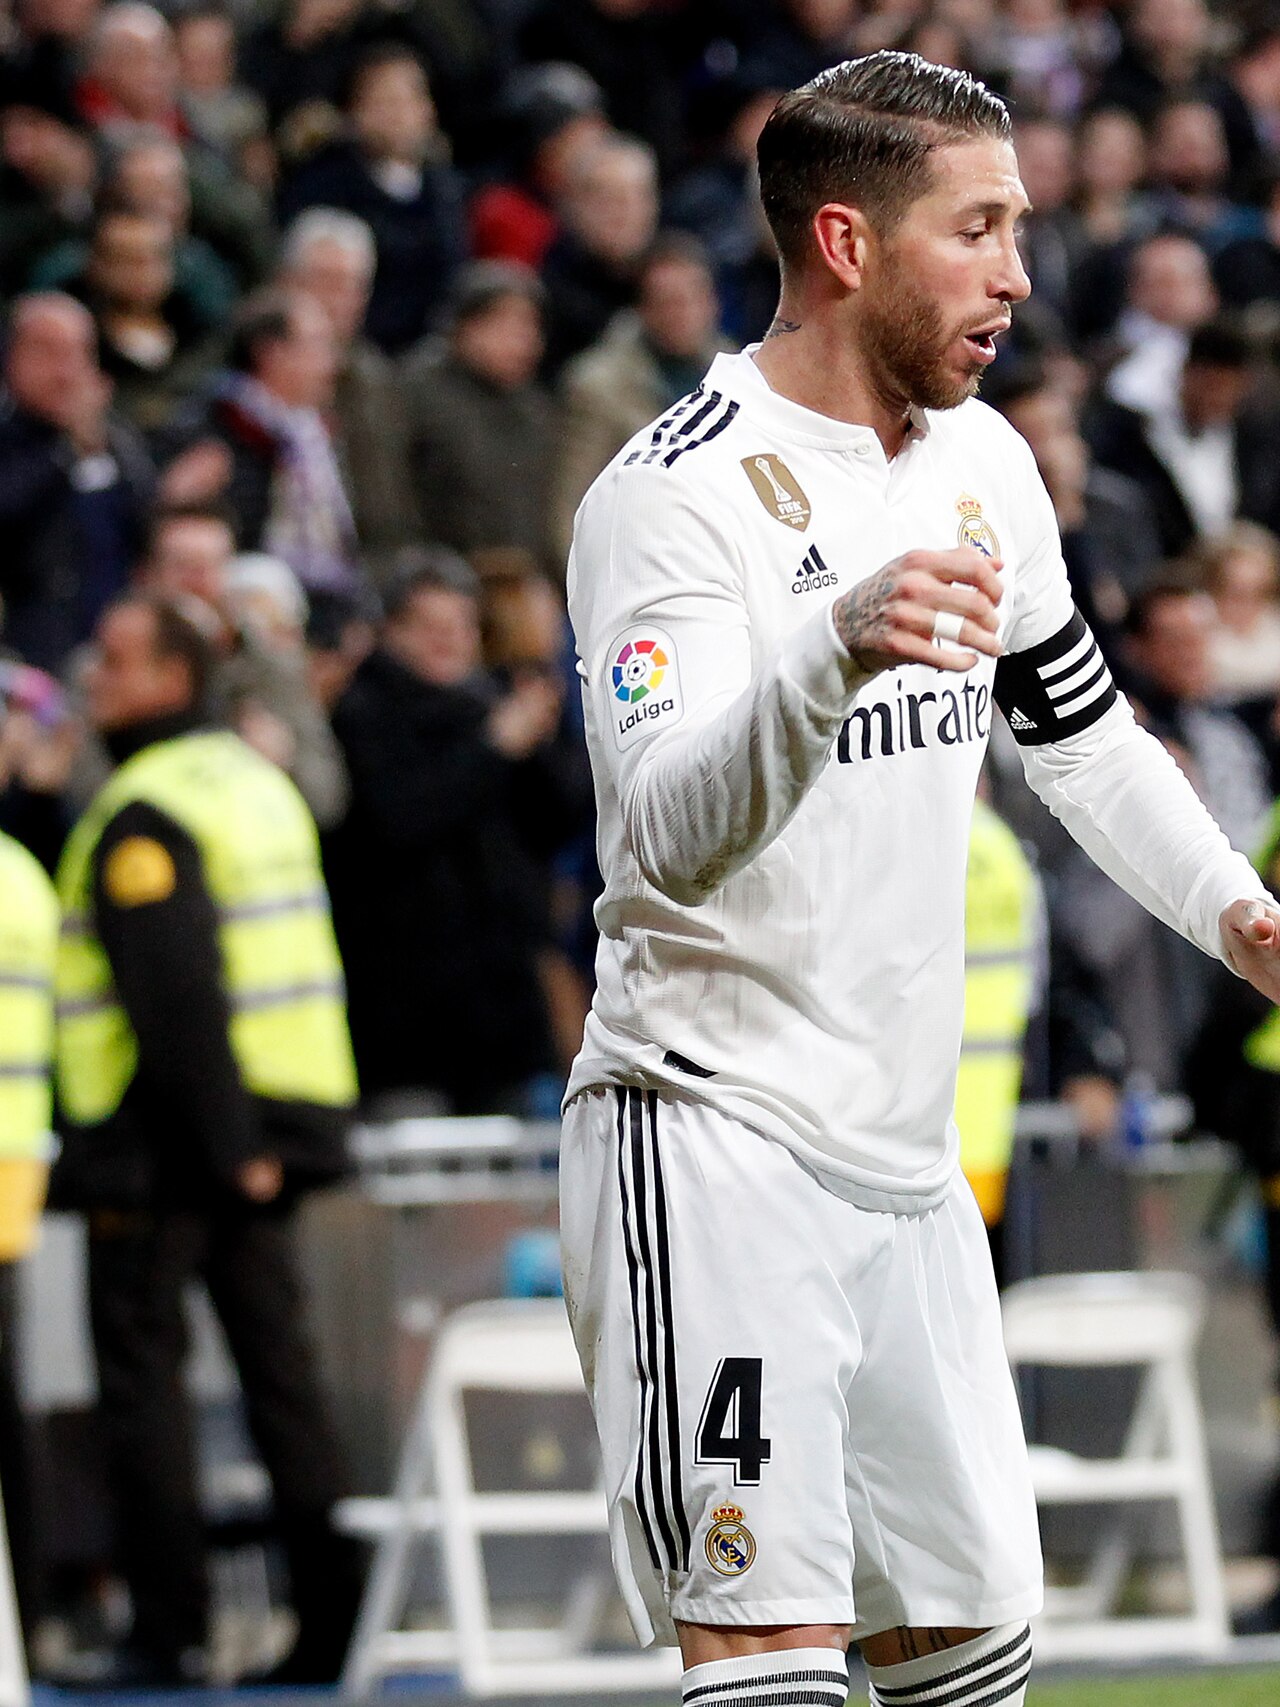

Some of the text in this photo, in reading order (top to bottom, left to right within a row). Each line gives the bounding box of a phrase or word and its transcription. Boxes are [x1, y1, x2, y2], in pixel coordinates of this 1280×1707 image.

[777, 500, 803, 515] FIFA
[791, 572, 839, 594] adidas
[618, 699, 674, 735] LaLiga
[828, 676, 991, 765] mirate
[1010, 720, 1038, 730] adidas
[694, 1357, 771, 1487] 4
